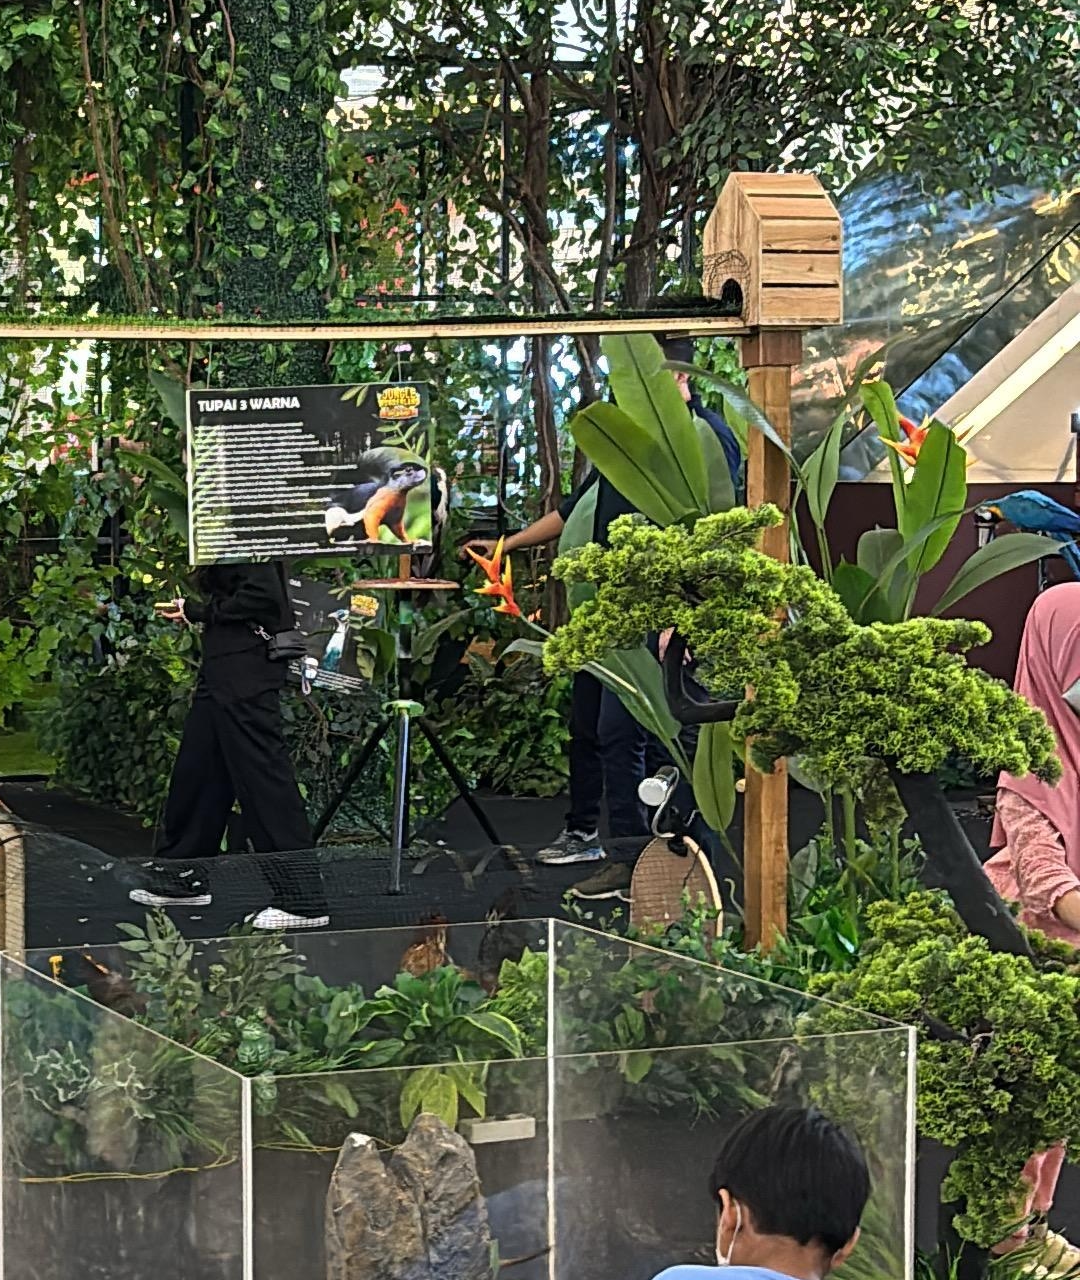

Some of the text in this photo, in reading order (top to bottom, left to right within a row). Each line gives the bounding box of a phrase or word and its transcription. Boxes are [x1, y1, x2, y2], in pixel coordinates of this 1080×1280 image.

[382, 387, 418, 400] JUNGLE
[197, 396, 301, 412] TUPAI 3 WARNA
